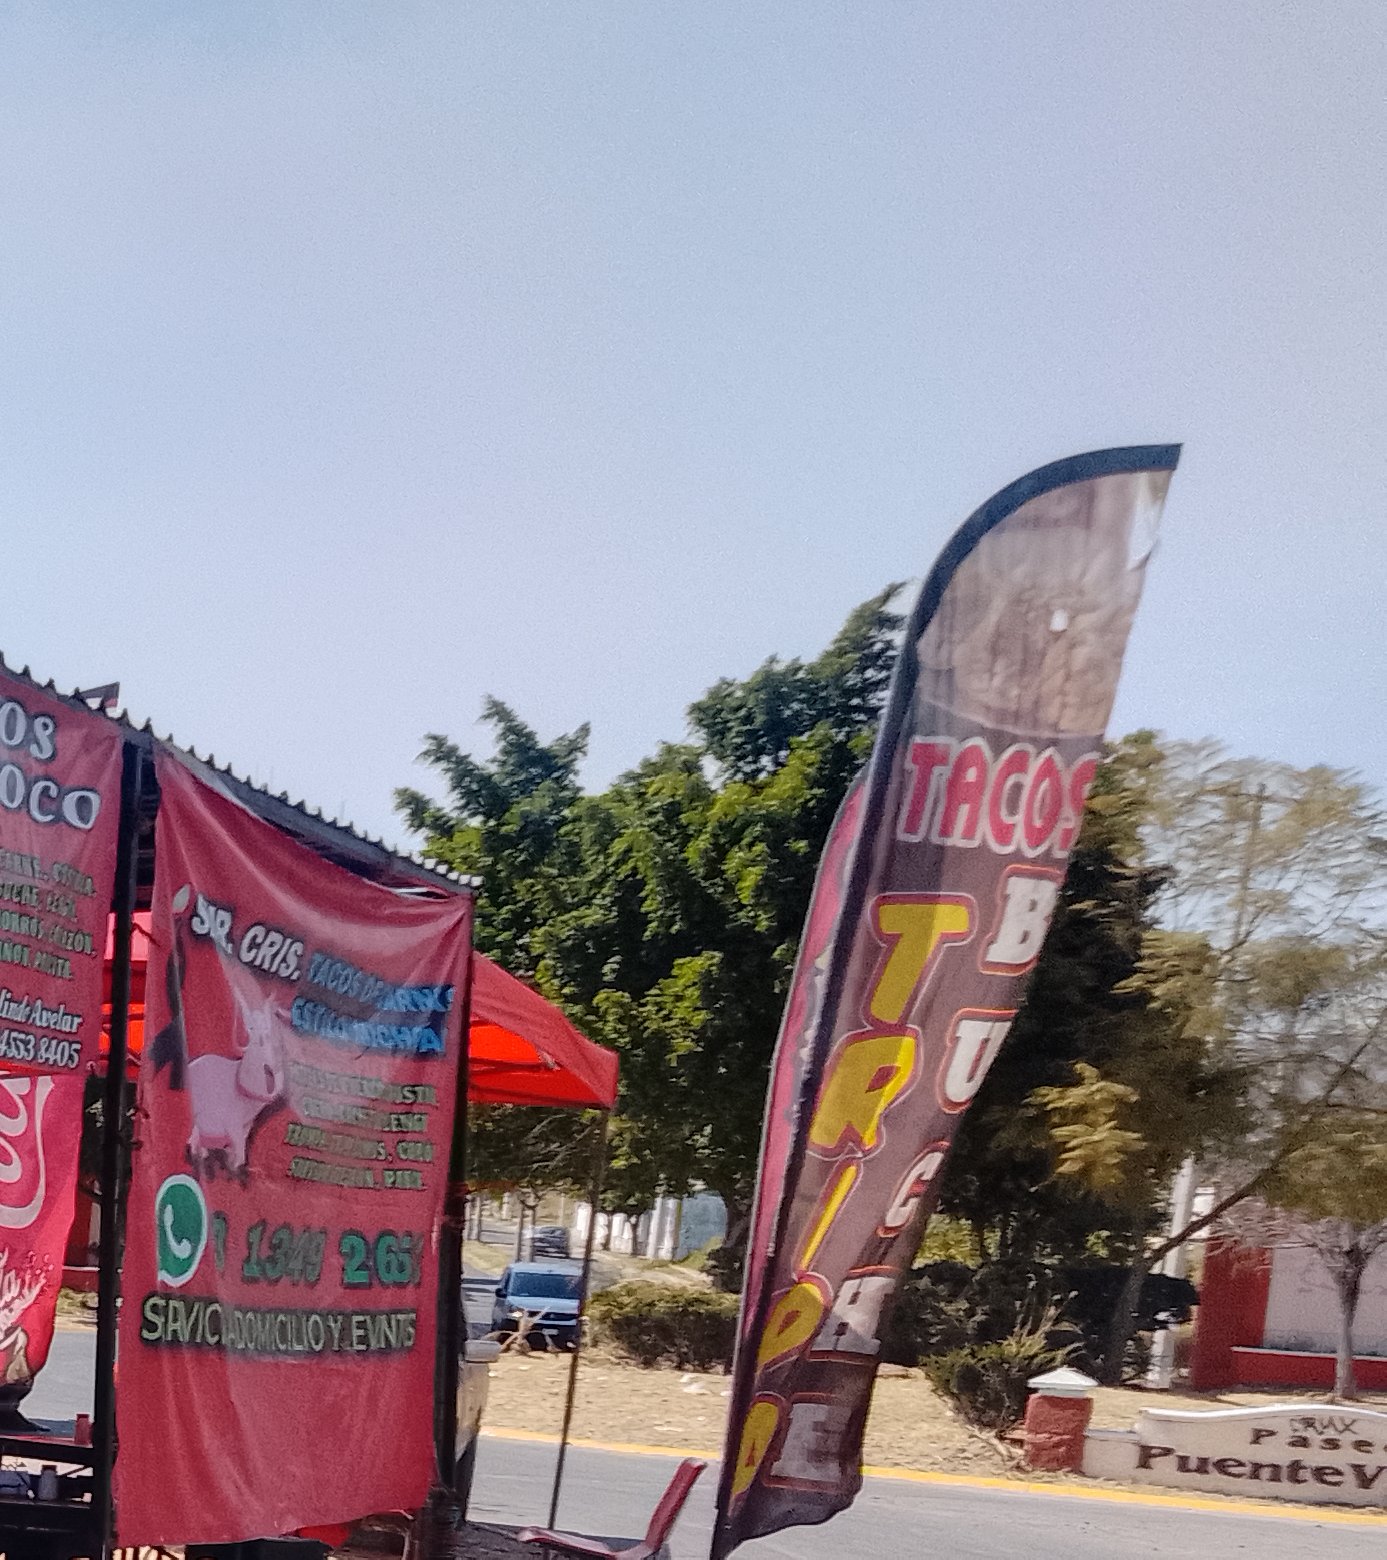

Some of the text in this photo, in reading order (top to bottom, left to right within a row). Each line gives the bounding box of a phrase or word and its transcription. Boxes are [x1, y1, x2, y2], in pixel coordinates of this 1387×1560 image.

[899, 739, 1098, 855] TACOS
[239, 925, 305, 981] CRIS.
[36, 1036, 82, 1069] 8405
[1249, 1427, 1387, 1455] Pase
[1136, 1445, 1345, 1488] Puente
